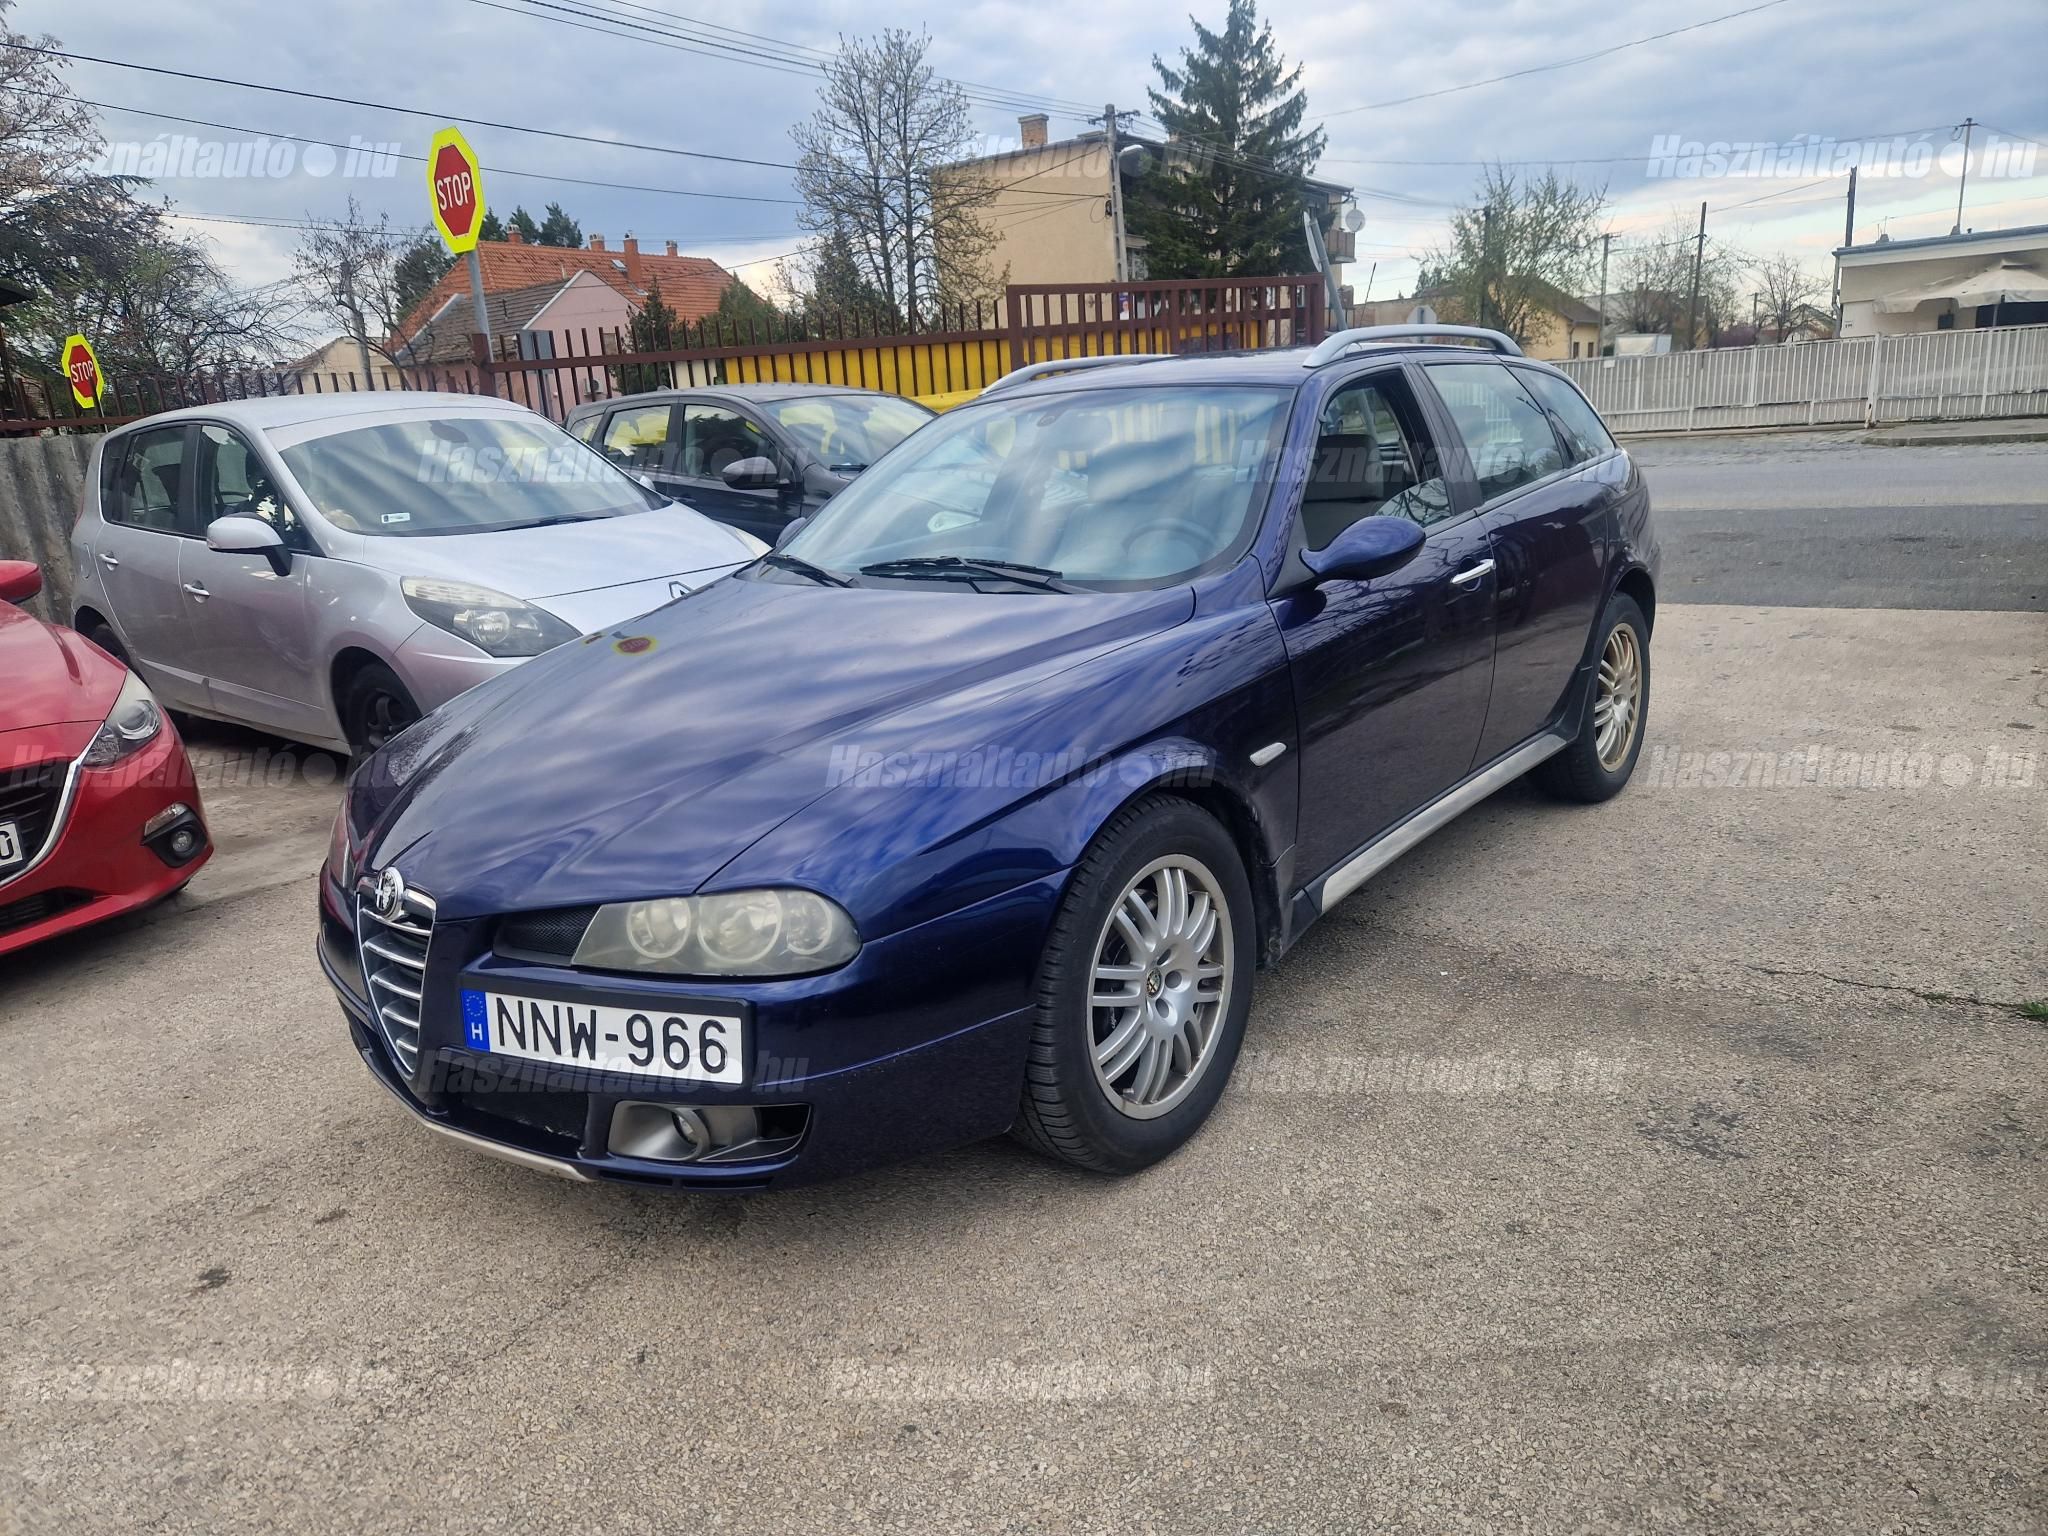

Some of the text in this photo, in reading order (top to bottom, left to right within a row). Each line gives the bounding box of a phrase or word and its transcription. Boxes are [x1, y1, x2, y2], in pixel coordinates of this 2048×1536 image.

[436, 171, 471, 211] STOP
[70, 360, 93, 383] STOP
[470, 1022, 483, 1041] H
[496, 997, 728, 1074] NNW-966
